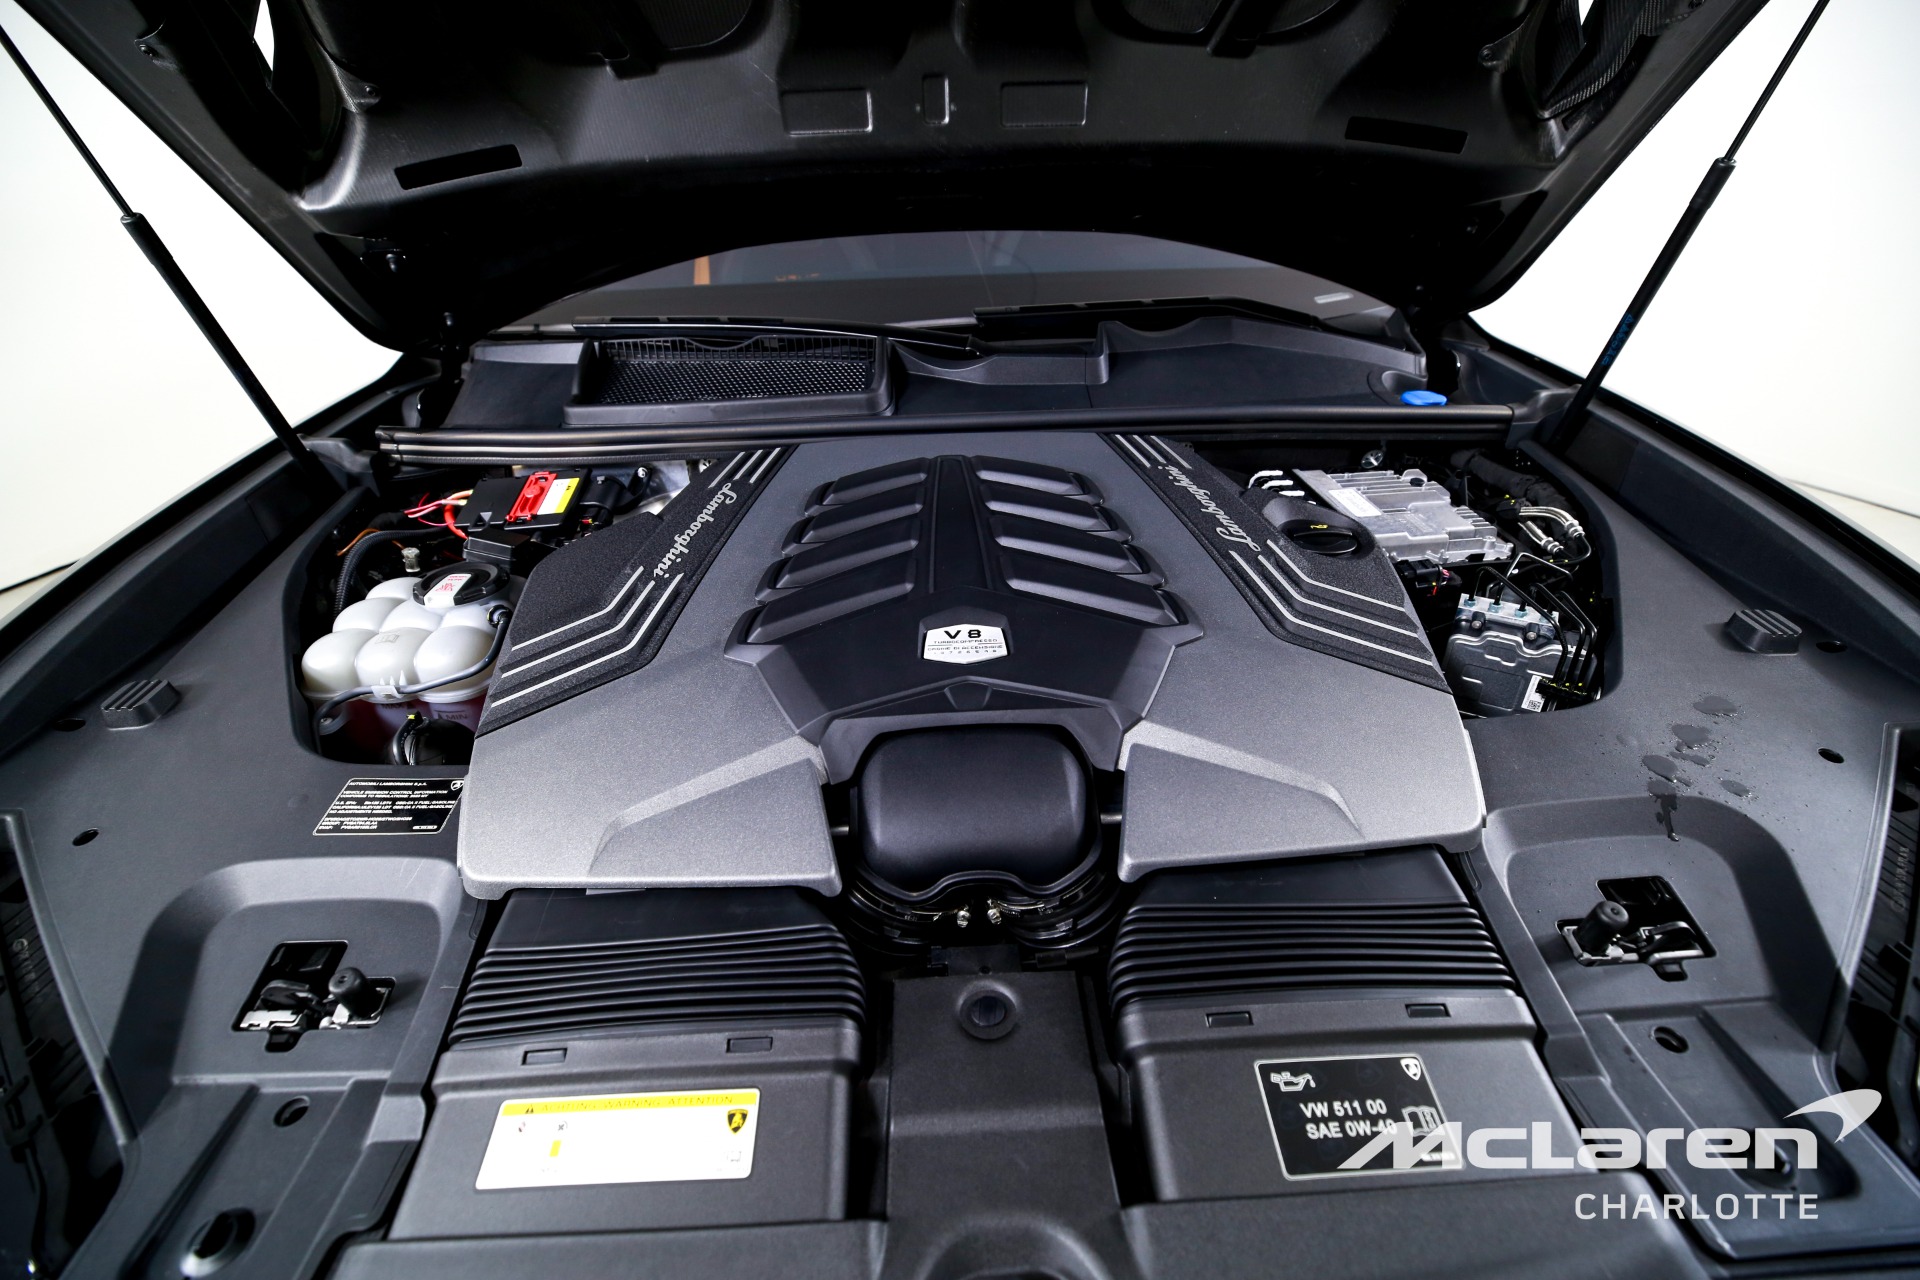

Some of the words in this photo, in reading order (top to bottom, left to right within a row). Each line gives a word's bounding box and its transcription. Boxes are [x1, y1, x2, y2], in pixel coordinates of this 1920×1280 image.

[1158, 465, 1260, 552] Lamborghini
[653, 483, 737, 578] Lamborghini
[944, 630, 981, 639] V8
[668, 1095, 733, 1105] ATTENTION
[1300, 1102, 1328, 1119] VW
[1333, 1101, 1360, 1117] 511
[1366, 1099, 1387, 1115] 00
[1305, 1122, 1343, 1140] SAE
